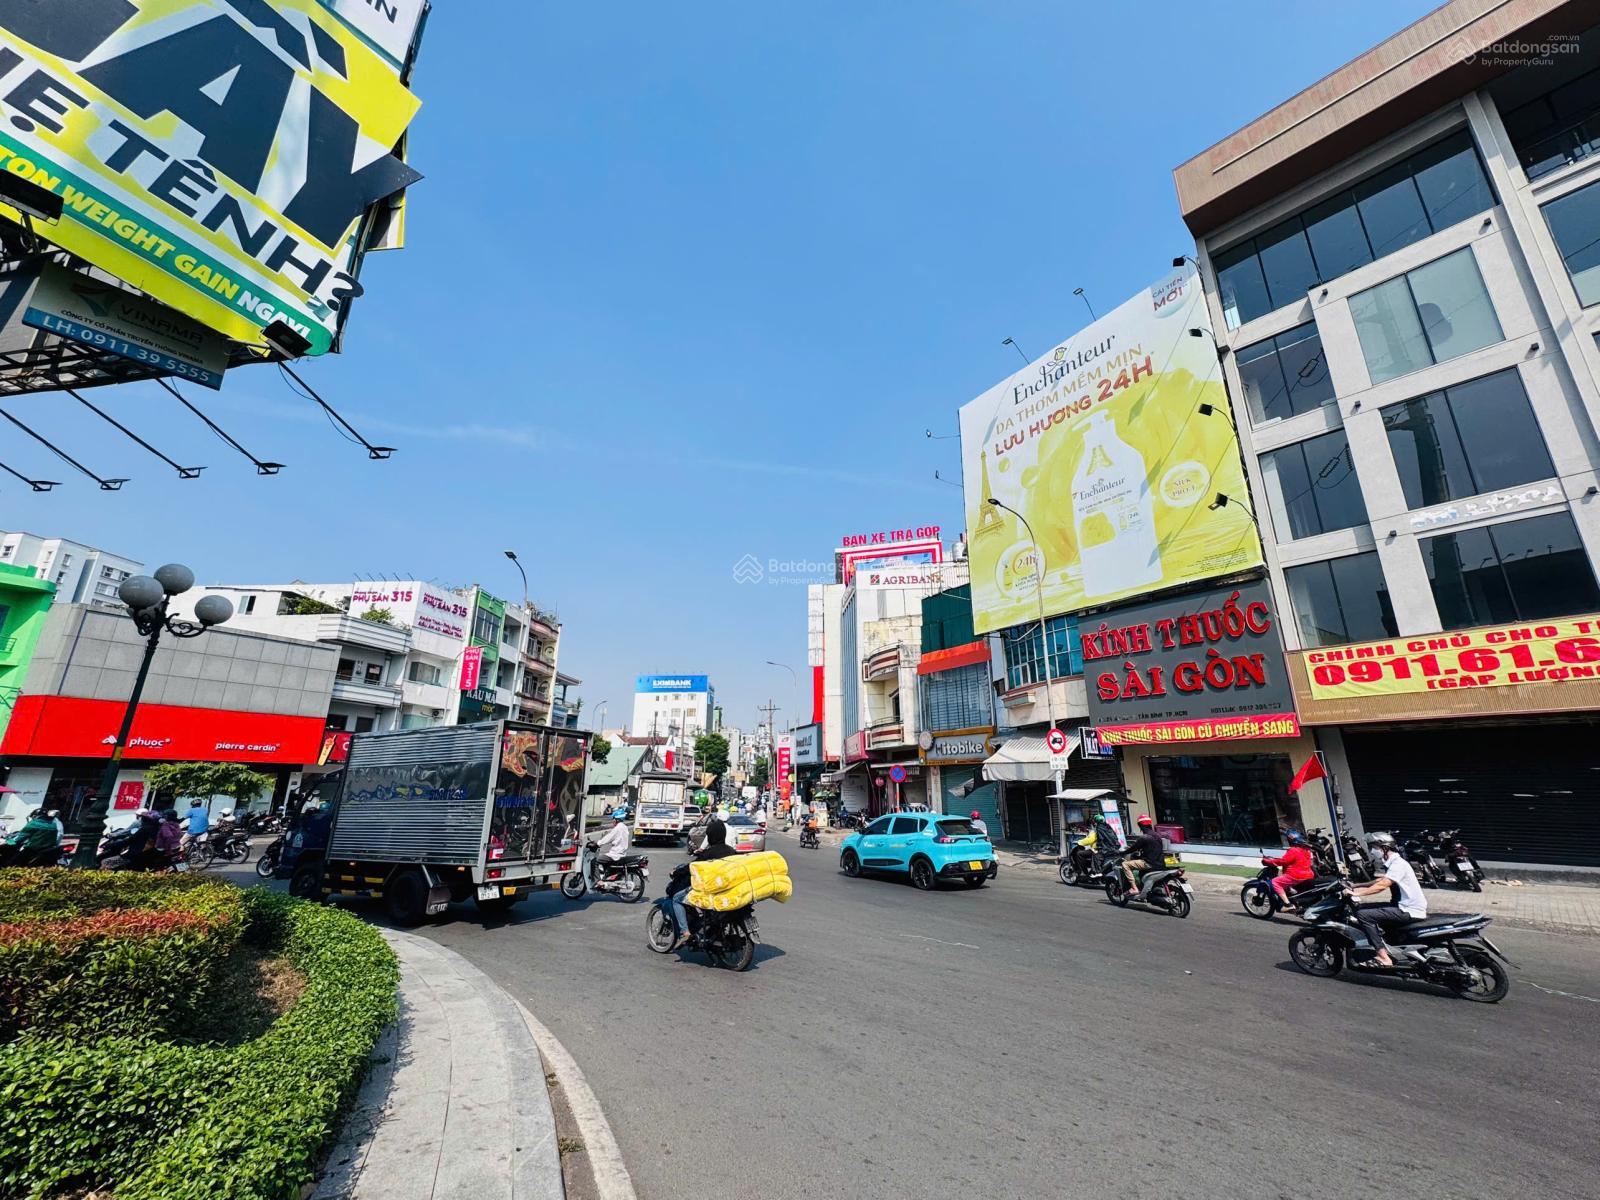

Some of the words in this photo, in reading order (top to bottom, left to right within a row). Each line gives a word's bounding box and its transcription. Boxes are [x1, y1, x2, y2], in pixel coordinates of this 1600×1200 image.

[61, 185, 175, 258] WEIGHT
[174, 255, 240, 300] GAIN
[42, 316, 75, 336] LH:
[80, 329, 129, 354] 0911
[136, 348, 161, 364] 39
[165, 359, 210, 382] 5555
[1013, 335, 1116, 405] Enchanteur
[1096, 355, 1154, 403] 24H
[996, 415, 1015, 435] DA
[871, 532, 886, 543] XE
[883, 574, 944, 585] AGRIBANK
[391, 591, 413, 602] 315
[452, 603, 468, 618] 315
[1081, 622, 1153, 661] KÍNH
[1156, 591, 1272, 649] THUỐC
[1308, 643, 1395, 663] CHÍNH
[1407, 633, 1471, 653] CHỦ
[1485, 625, 1559, 644] CHO
[1097, 661, 1167, 701] SÀI
[1174, 648, 1266, 692] GÒN
[1508, 665, 1600, 684] LƯỢN
[1262, 720, 1294, 735] SANG
[215, 741, 245, 751] pierre
